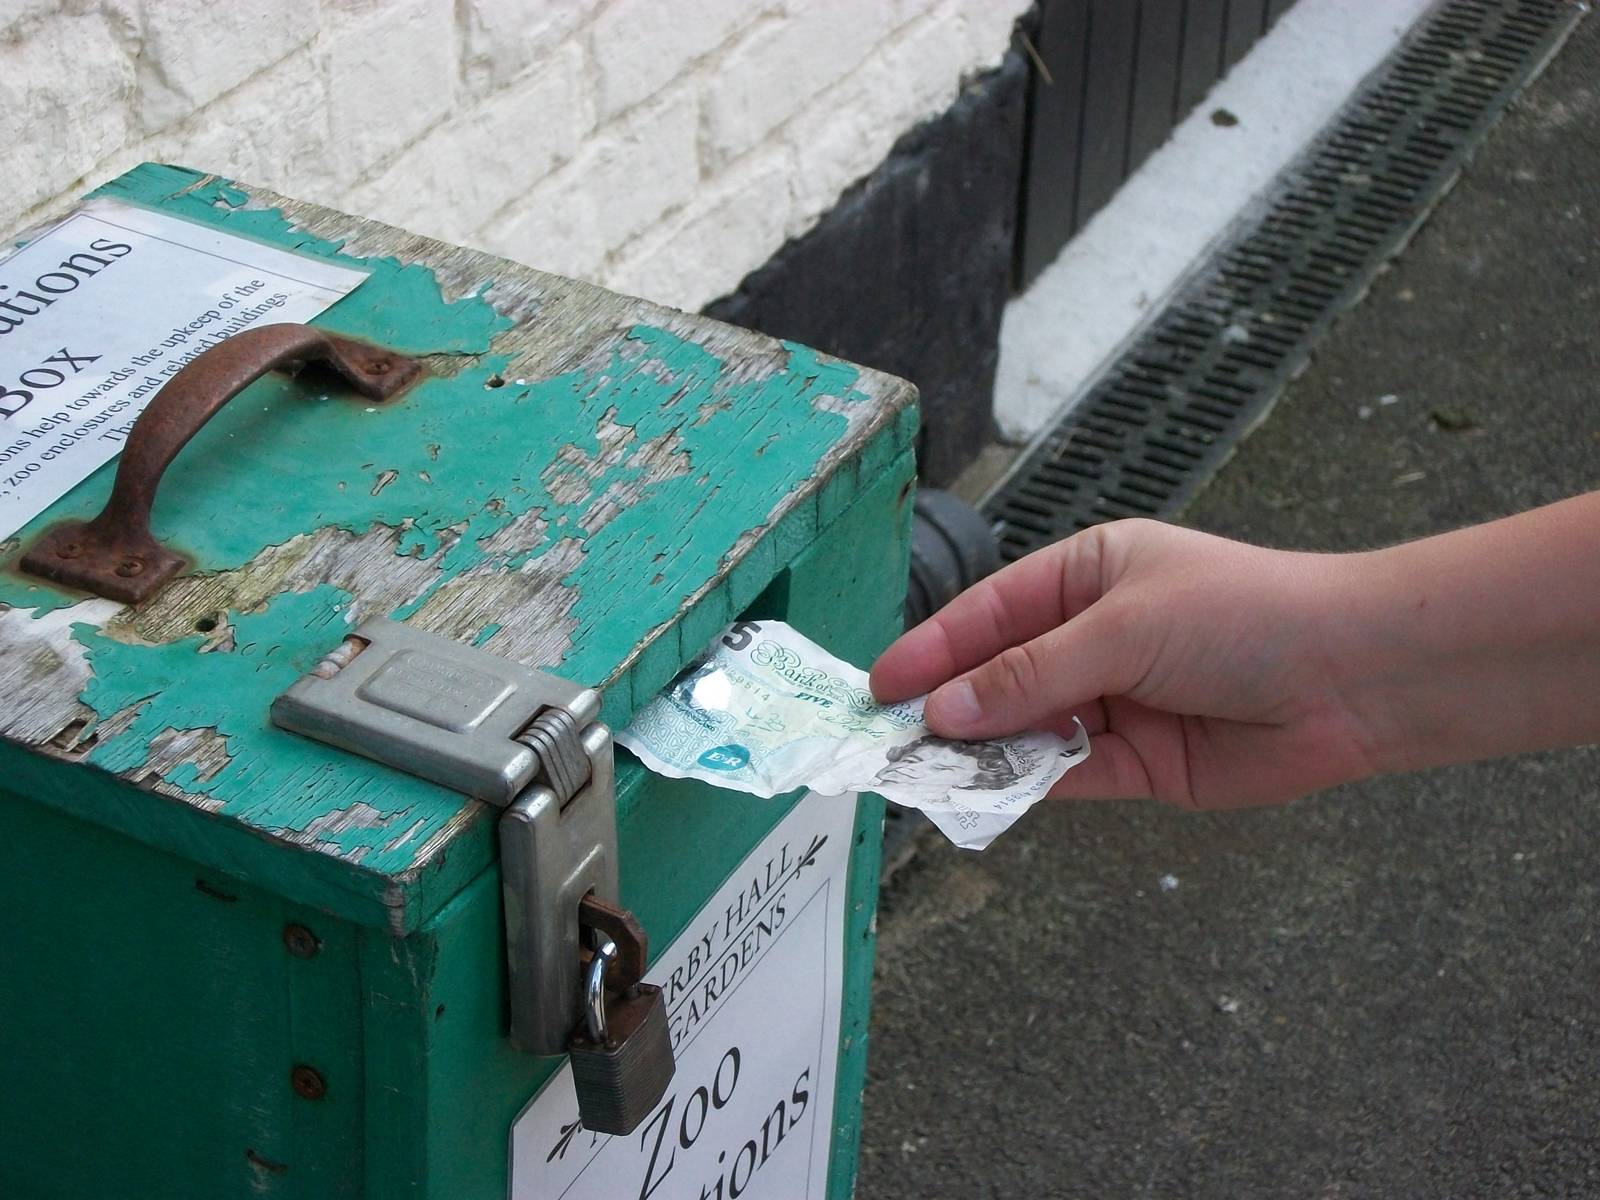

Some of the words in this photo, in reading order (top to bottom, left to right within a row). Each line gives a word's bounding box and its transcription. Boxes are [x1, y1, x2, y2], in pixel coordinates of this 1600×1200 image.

[3, 462, 42, 487] zoo
[40, 399, 131, 461] enclosures
[127, 376, 163, 399] and
[159, 338, 217, 379] related
[207, 291, 293, 340] buildings.
[22, 411, 72, 438] help
[65, 366, 137, 411] towards
[132, 347, 164, 367] the
[160, 309, 223, 349] upkeep
[217, 293, 240, 310] of
[234, 279, 265, 297] the
[722, 621, 762, 651] 5
[661, 920, 720, 1007] RBY
[723, 842, 794, 942] HALL
[669, 892, 787, 1051] GARDENS
[638, 1046, 742, 1200] Zoo
